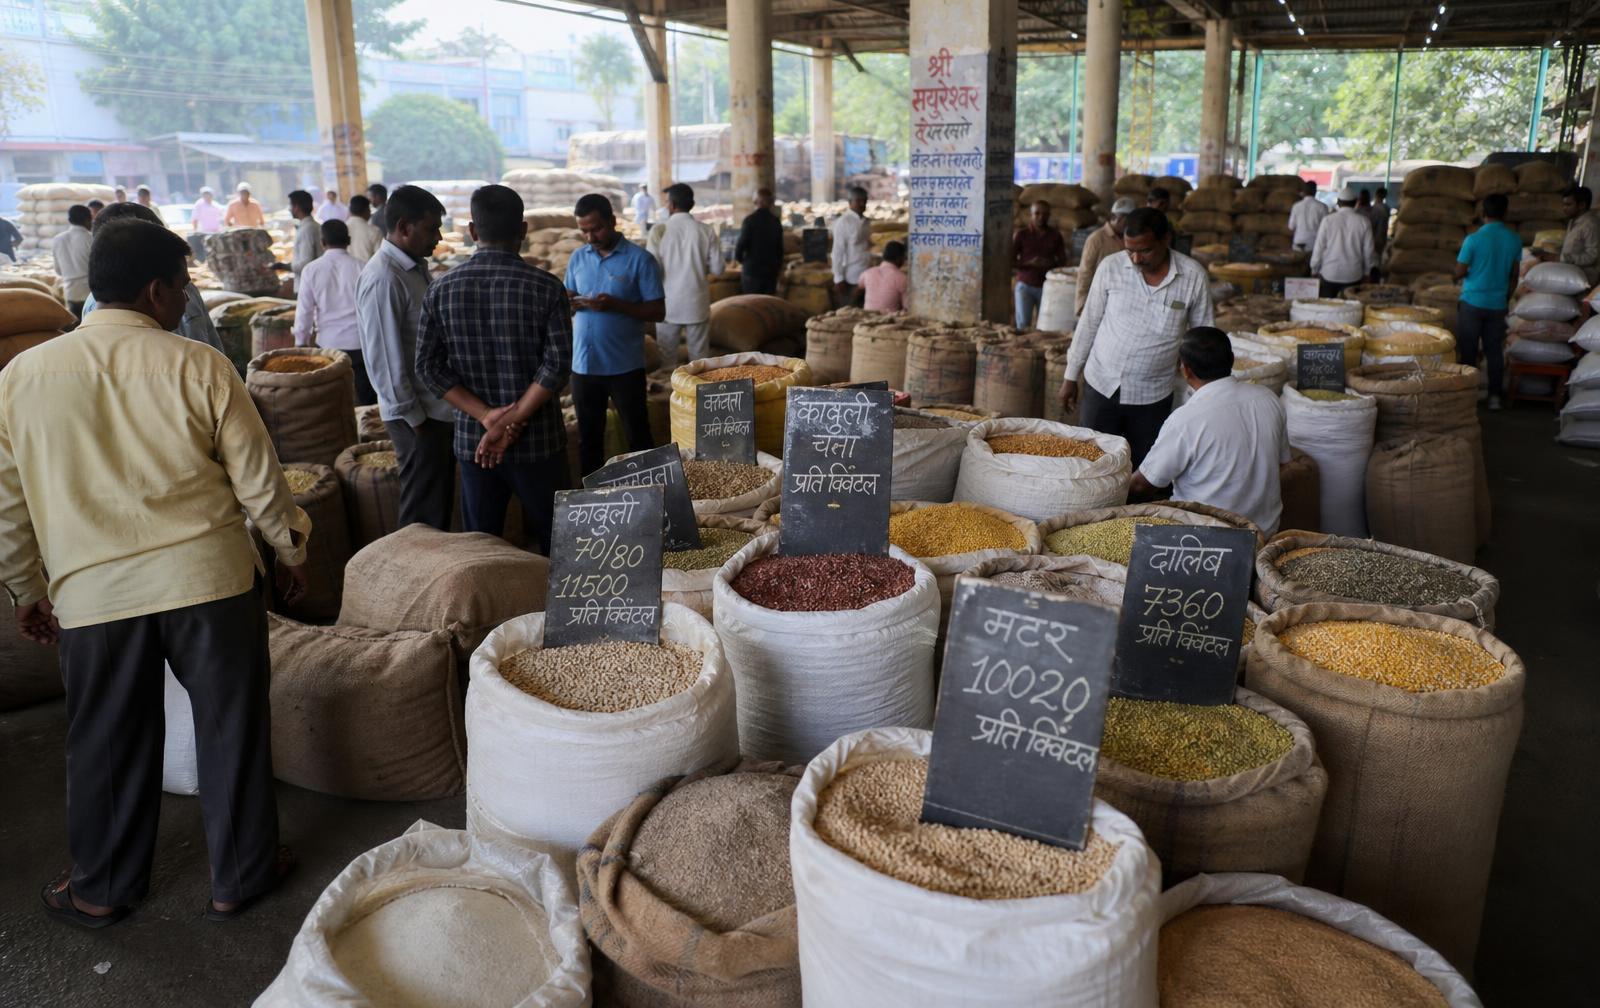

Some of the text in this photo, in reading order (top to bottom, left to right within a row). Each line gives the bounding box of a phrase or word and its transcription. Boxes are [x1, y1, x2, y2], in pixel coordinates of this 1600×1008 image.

[928, 48, 954, 77] श्री
[790, 465, 826, 493] प्रति
[575, 535, 644, 570] 70/80
[1150, 534, 1232, 577] दालिब
[555, 574, 628, 599] 11500
[1144, 584, 1224, 619] 7360
[566, 599, 603, 626] प्रति
[983, 607, 1079, 663] मटर
[1136, 619, 1175, 646] प्रति
[971, 709, 1027, 750] प्रति
